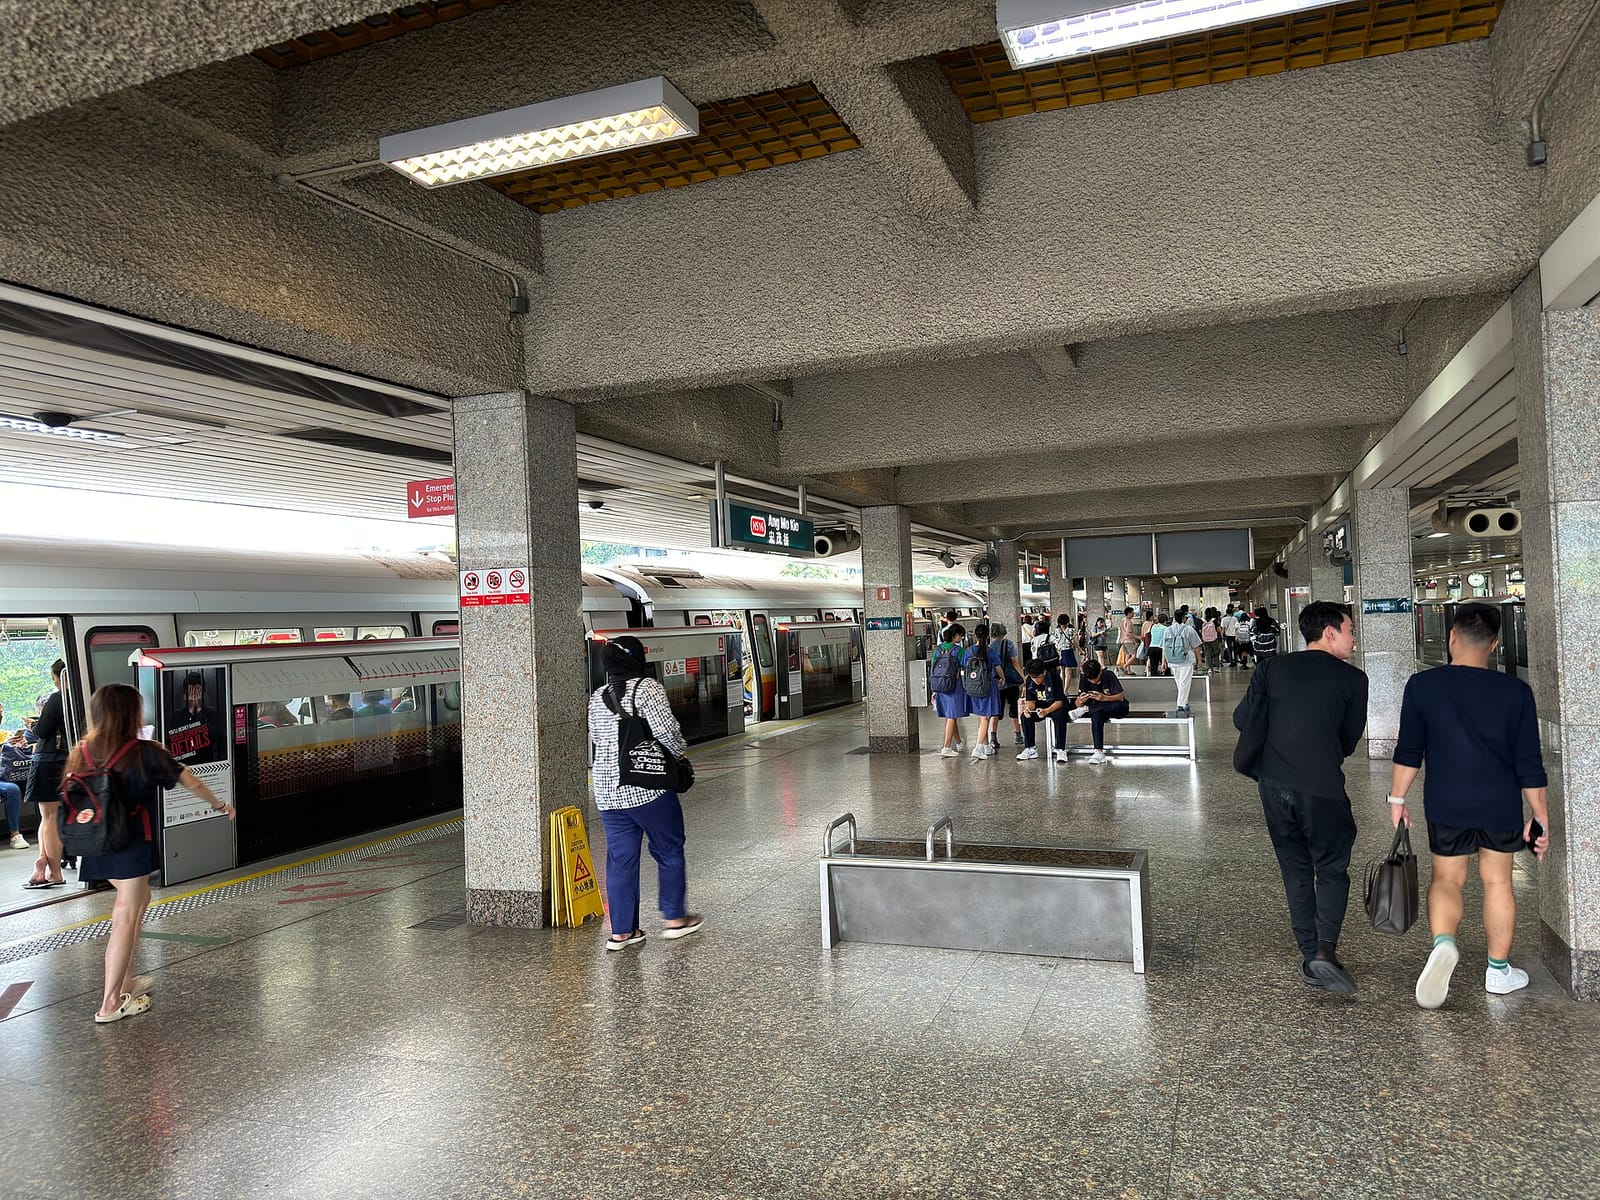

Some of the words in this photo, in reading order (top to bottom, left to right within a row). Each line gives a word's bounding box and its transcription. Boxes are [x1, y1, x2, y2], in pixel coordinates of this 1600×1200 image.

[426, 494, 442, 504] Stop
[768, 514, 780, 531] Ang
[780, 516, 789, 530] Mo
[790, 519, 799, 532] Kio
[170, 731, 210, 758] DETAILS
[637, 756, 661, 764] Class
[646, 763, 664, 771] 2021
